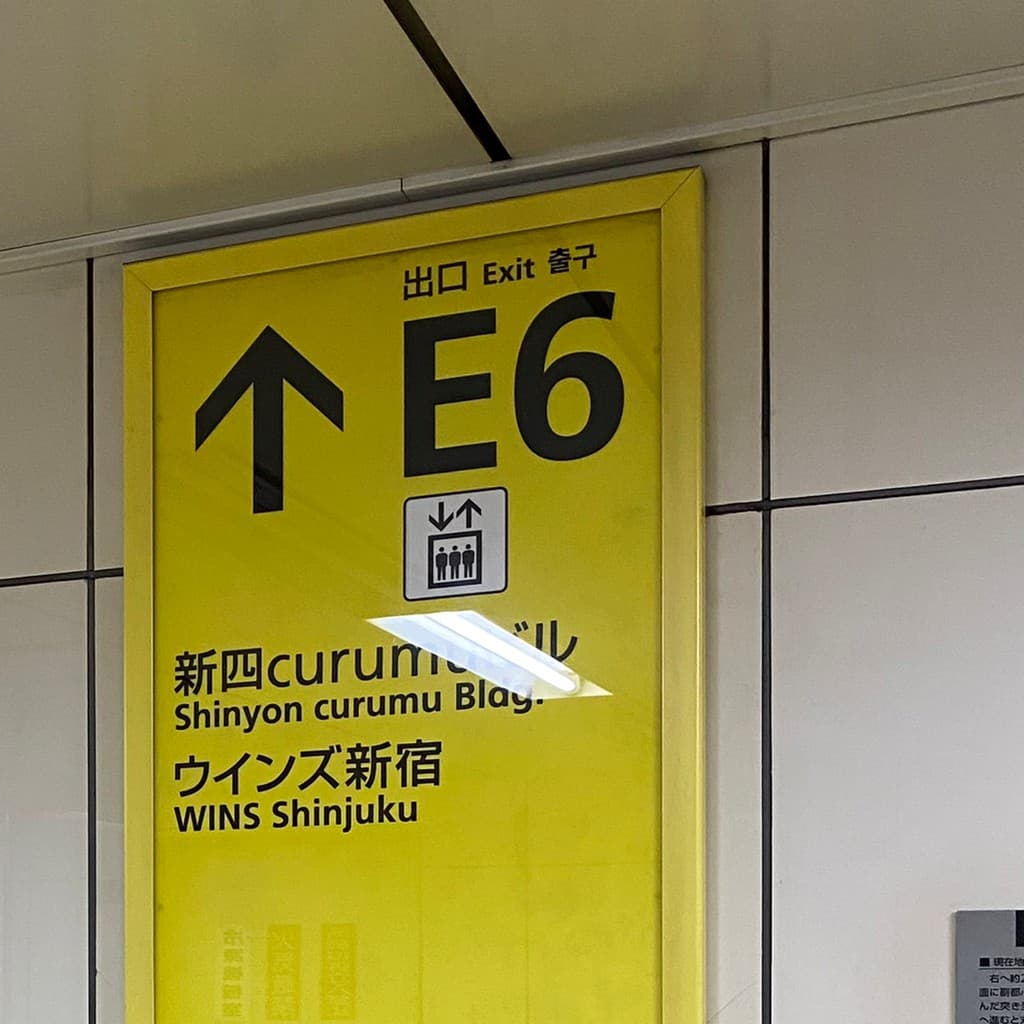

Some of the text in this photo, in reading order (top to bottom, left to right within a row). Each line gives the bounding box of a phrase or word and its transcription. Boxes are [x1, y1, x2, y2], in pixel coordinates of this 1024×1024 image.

[404, 243, 597, 301] 出口 Exit 출구
[403, 290, 625, 478] E6
[174, 679, 544, 734] Shinyon curumu Bldg.
[174, 739, 442, 797] ウインズ新宿
[174, 794, 418, 833] WINS Shinjuku
